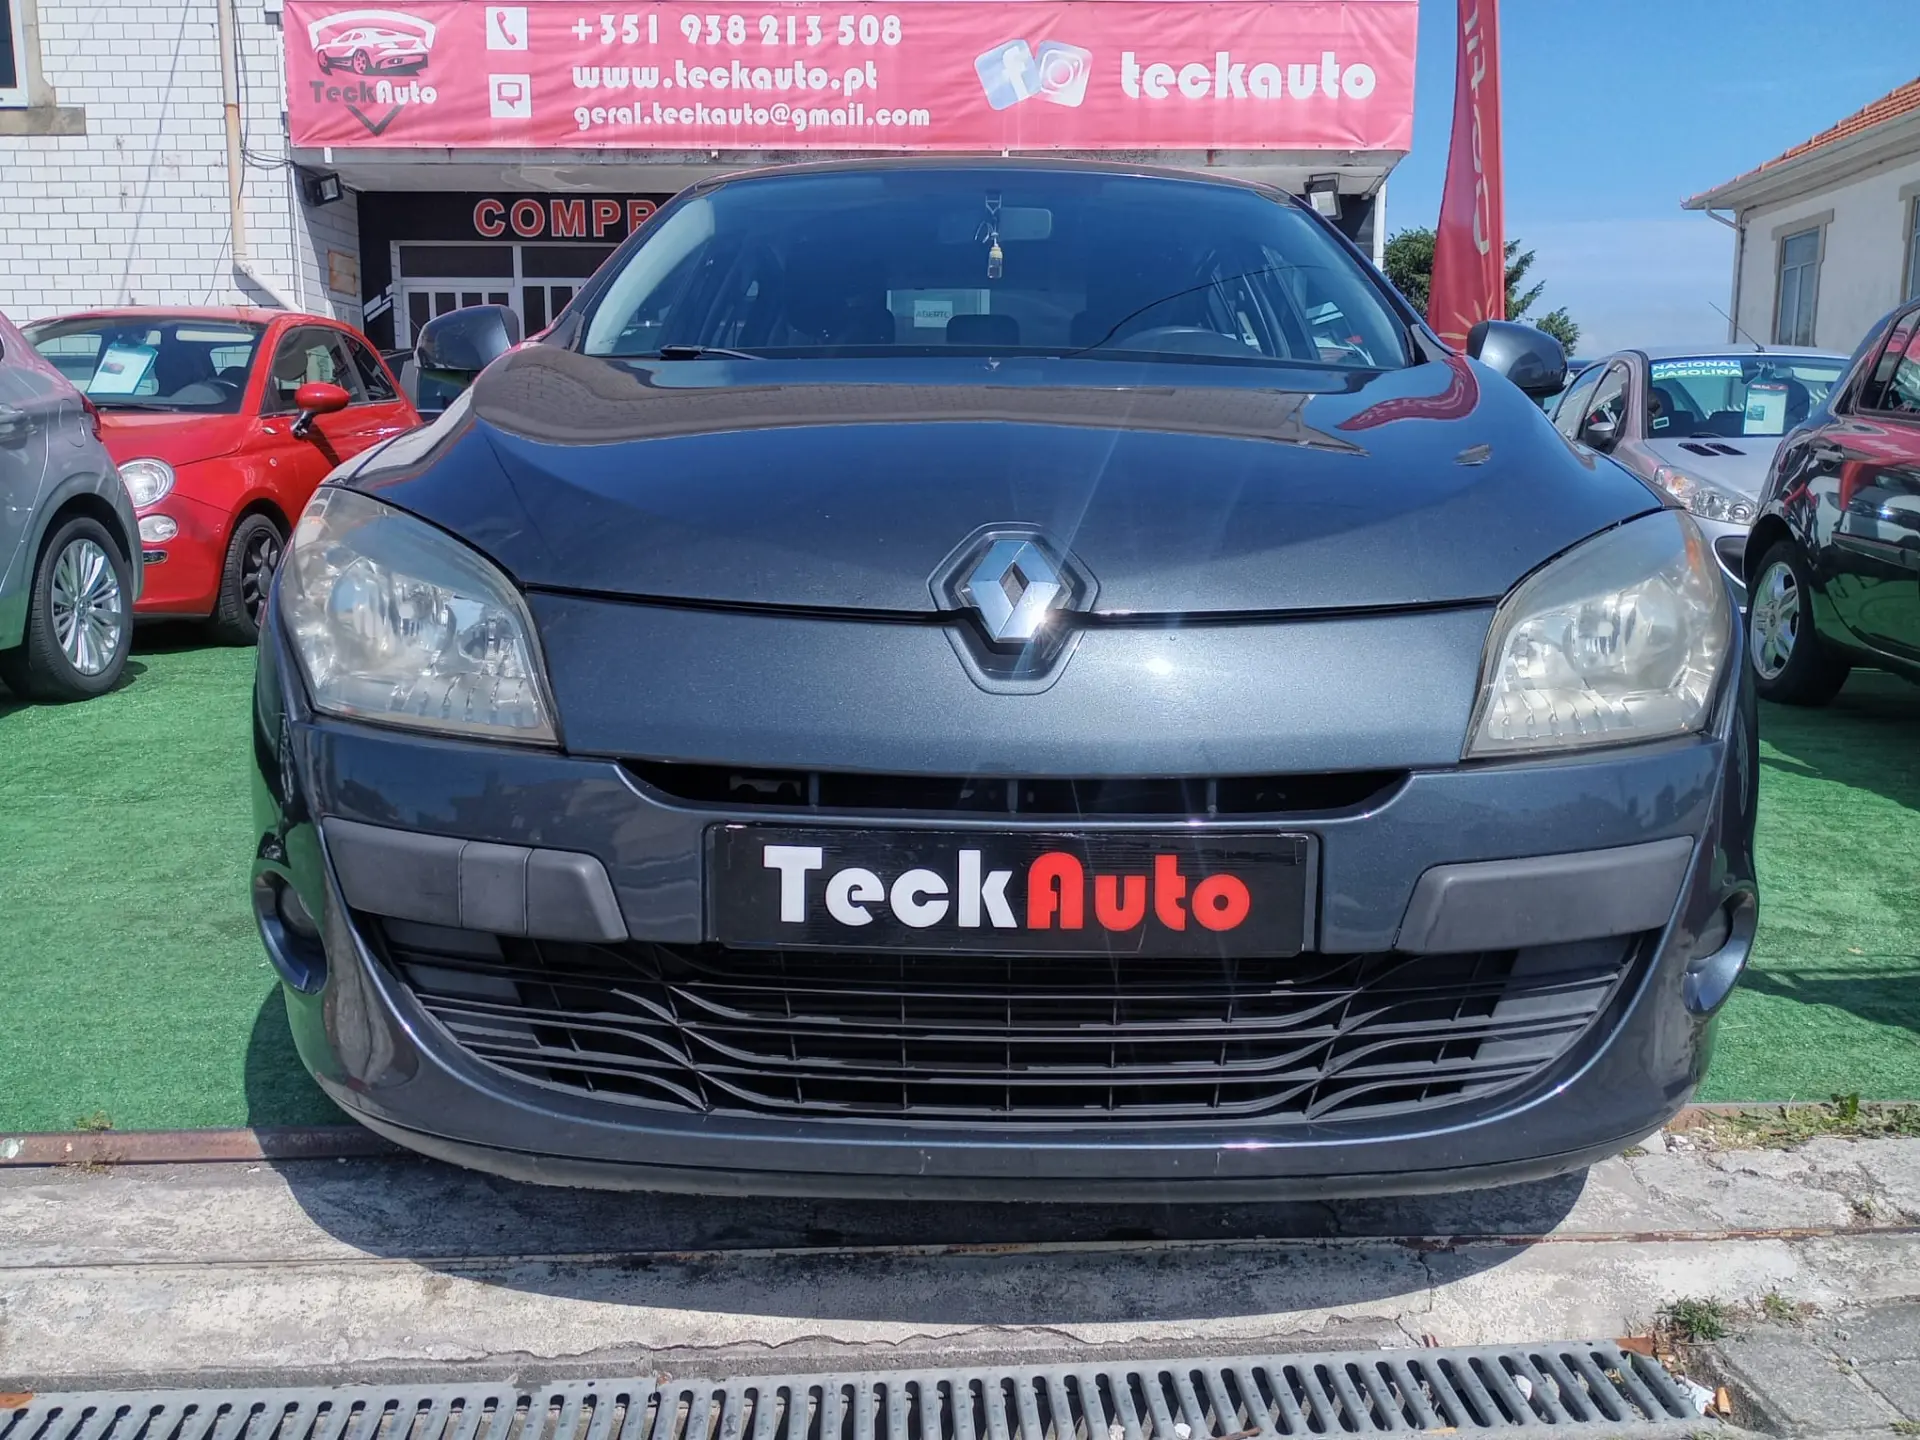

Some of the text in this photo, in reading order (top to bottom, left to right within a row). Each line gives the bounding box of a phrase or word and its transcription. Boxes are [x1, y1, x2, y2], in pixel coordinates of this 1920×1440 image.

[571, 14, 902, 46] +351 938 213 508
[572, 59, 878, 97] www.teckauto.pt
[1120, 51, 1377, 100] teckauto
[309, 79, 438, 105] TeckAuto
[573, 102, 930, 132] geral.teckauto@gmail.com
[1652, 361, 1740, 370] NACIONAL
[1653, 369, 1743, 379] GASOLINA
[763, 845, 1251, 931] TeckAuto
